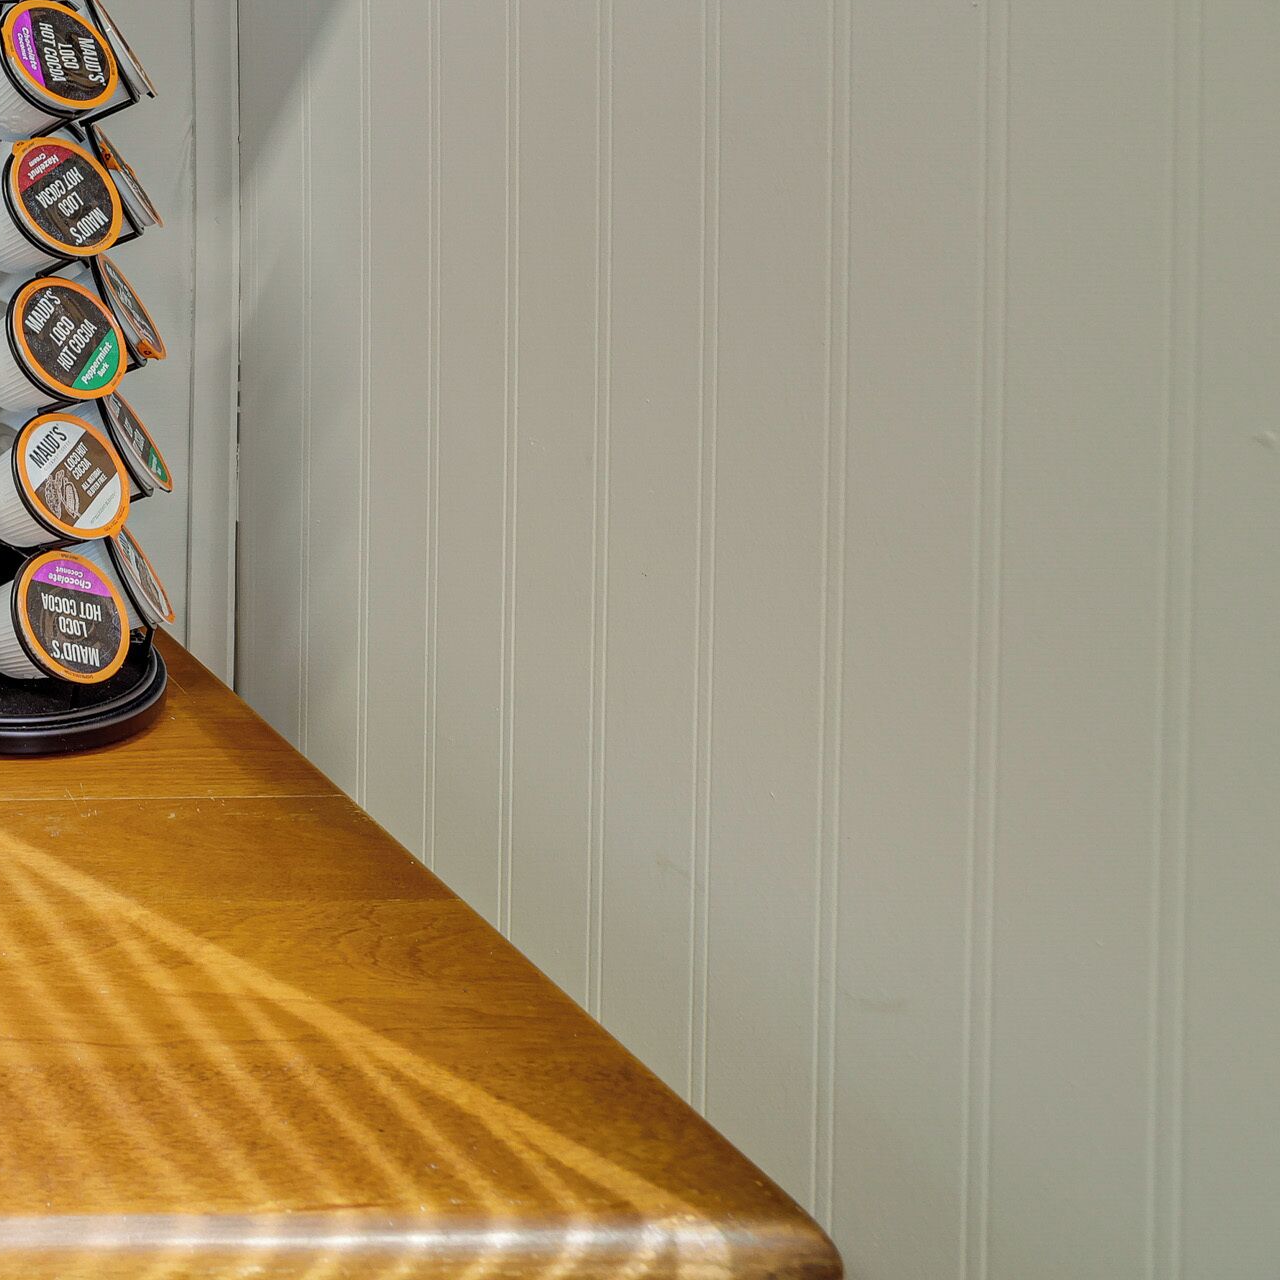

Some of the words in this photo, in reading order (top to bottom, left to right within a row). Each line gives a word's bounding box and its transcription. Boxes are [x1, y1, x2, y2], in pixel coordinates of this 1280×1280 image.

[39, 22, 56, 47] HOT
[44, 47, 67, 82] COCOA
[58, 42, 80, 70] LOCO
[78, 37, 106, 86] MAUD'S
[27, 154, 60, 180] Hazelnut
[63, 166, 84, 189] HOT
[35, 179, 67, 209] COCOA
[57, 191, 84, 217] LOCO
[69, 207, 109, 245] MAUD'S
[25, 288, 61, 334] MAUD'S
[49, 315, 75, 347] LOCO
[56, 344, 77, 372] HOT
[68, 318, 98, 354] COCOA
[81, 341, 113, 385] Peppermint
[29, 425, 67, 469] MAUD'S
[71, 457, 92, 480] COCOA
[48, 572, 92, 589] Chocolate
[55, 566, 84, 578] Coconut
[41, 592, 77, 616] COCOA
[79, 601, 102, 622] HOT
[58, 616, 88, 638] LOCO
[51, 640, 101, 667] MAUD'S
